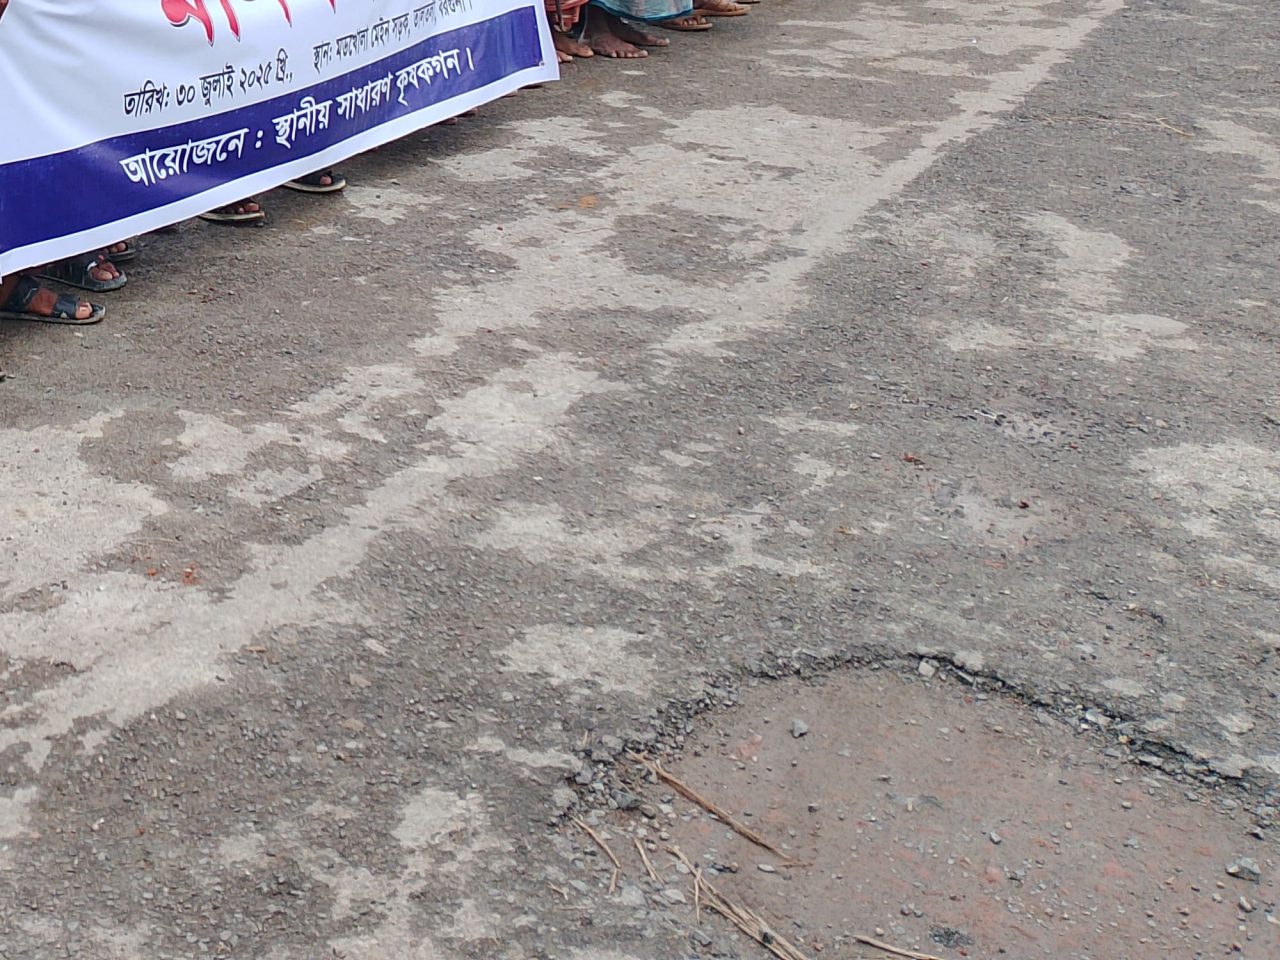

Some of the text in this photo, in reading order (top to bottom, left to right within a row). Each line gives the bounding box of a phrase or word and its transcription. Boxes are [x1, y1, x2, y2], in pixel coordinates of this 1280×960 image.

[119, 127, 250, 187] আয়োজনে
[271, 95, 333, 149] স্থানীয়
[336, 71, 394, 121] সাধারণ
[395, 49, 460, 107] কৃষকগন
[123, 79, 170, 117] তারিখ:
[175, 84, 196, 106] ৩০
[199, 63, 236, 108] জুলাই
[239, 61, 272, 92] ২০২৫
[371, 17, 391, 48] মেইন
